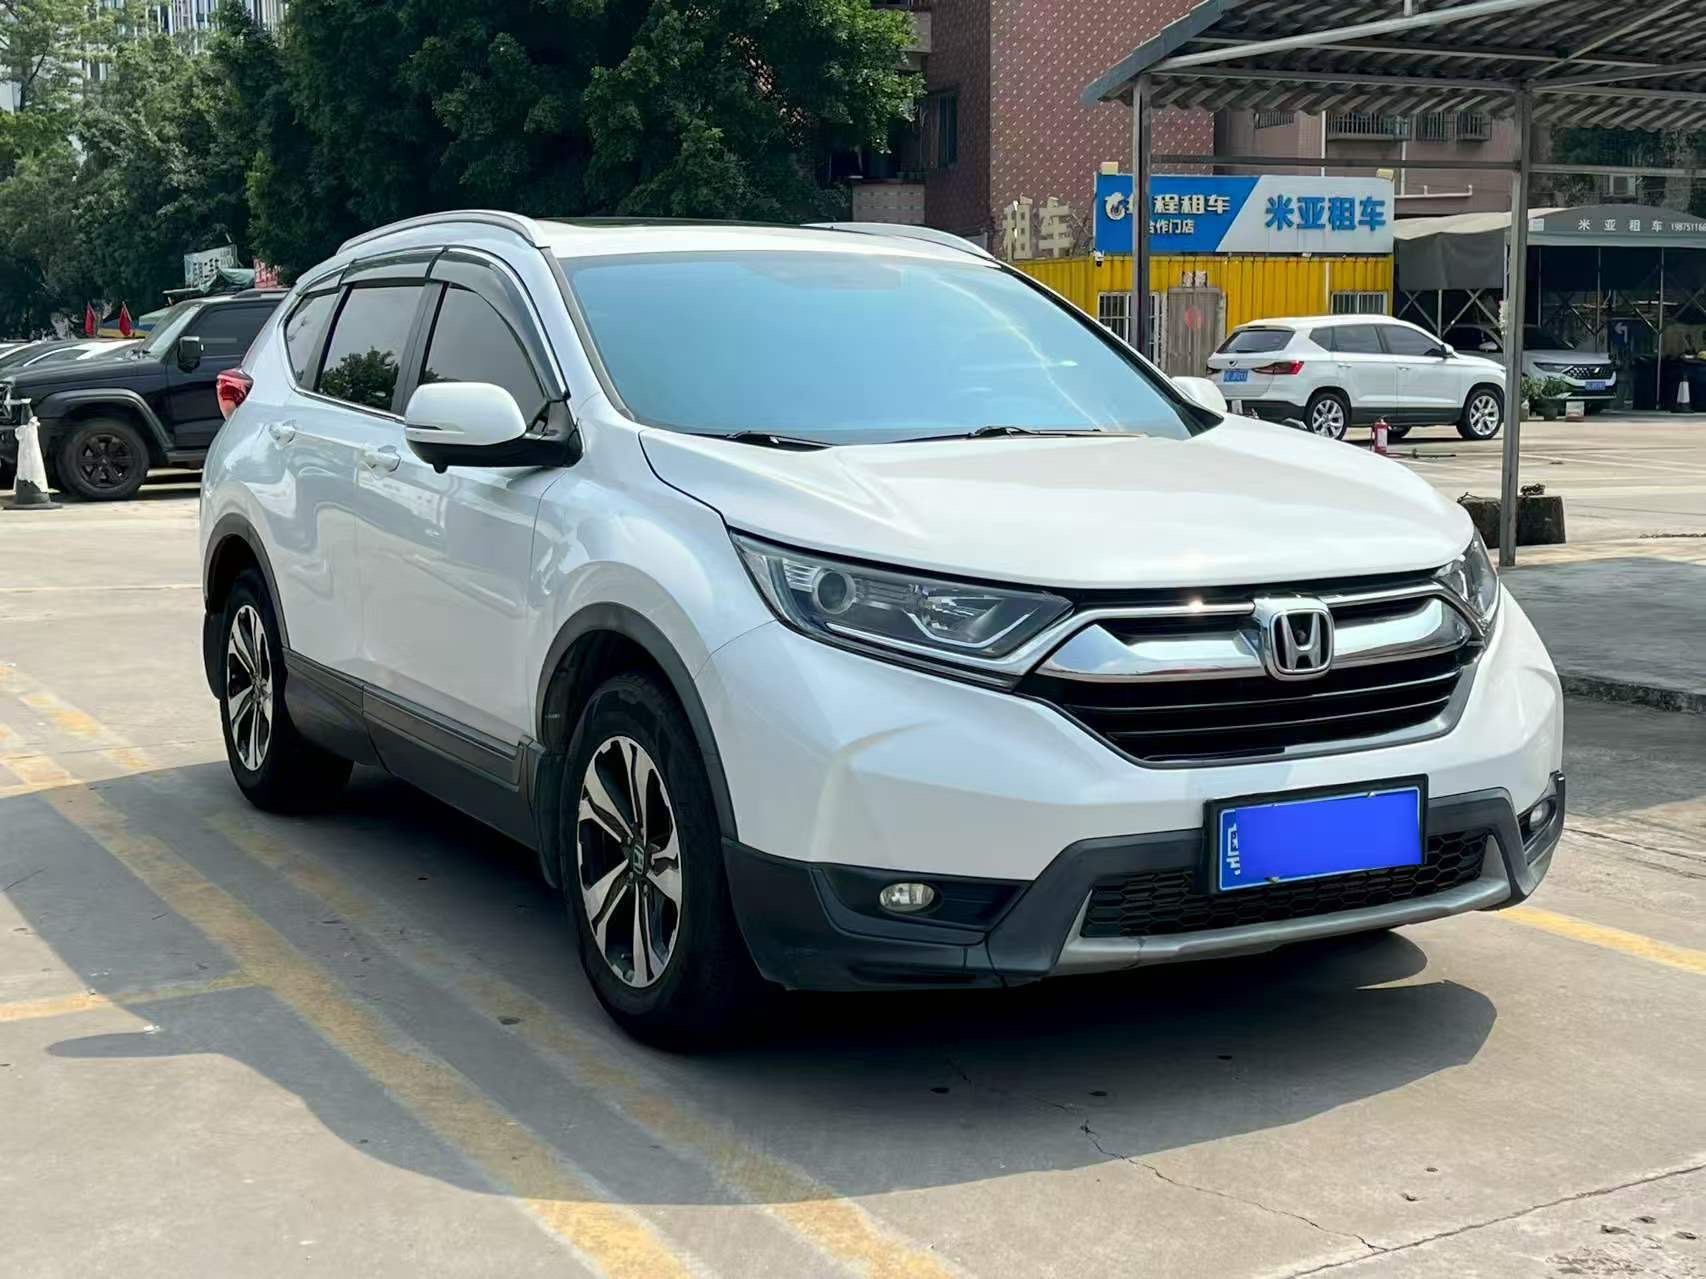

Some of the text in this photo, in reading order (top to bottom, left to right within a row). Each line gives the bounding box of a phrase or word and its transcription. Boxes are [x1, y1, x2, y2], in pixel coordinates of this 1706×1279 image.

[1265, 194, 1386, 231] 米亚租车
[1577, 218, 1663, 232] 米亚租车
